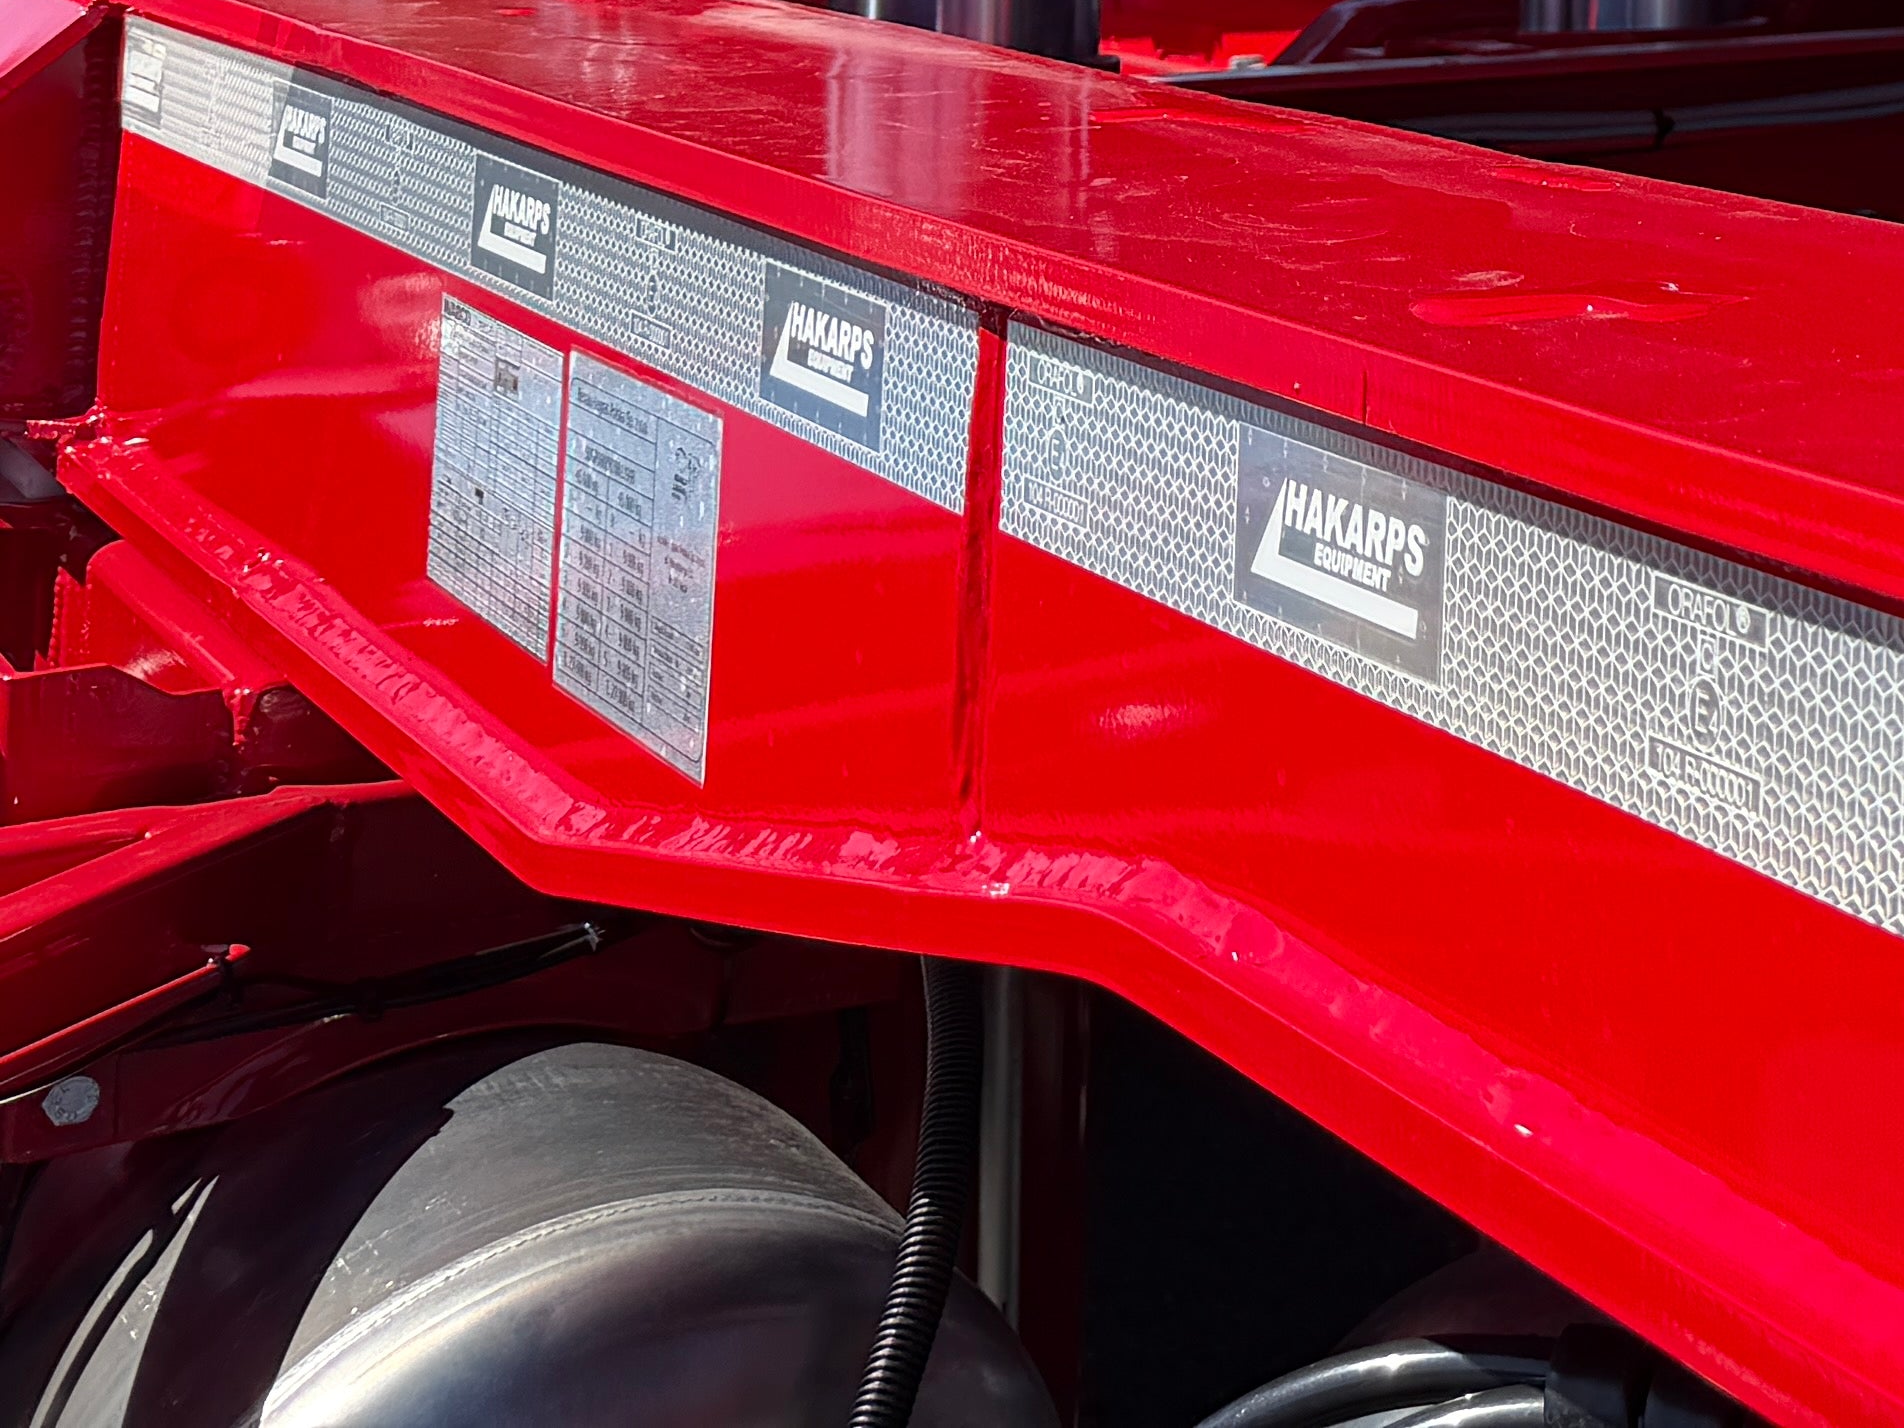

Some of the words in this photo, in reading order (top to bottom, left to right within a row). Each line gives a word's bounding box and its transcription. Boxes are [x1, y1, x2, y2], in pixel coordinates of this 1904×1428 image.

[491, 184, 551, 235] HAKARPS
[790, 301, 875, 370] HAKARPS
[1284, 479, 1429, 578] HAKARPS
[1313, 542, 1392, 592] EQUIPMENT
[1654, 742, 1681, 778] 104
